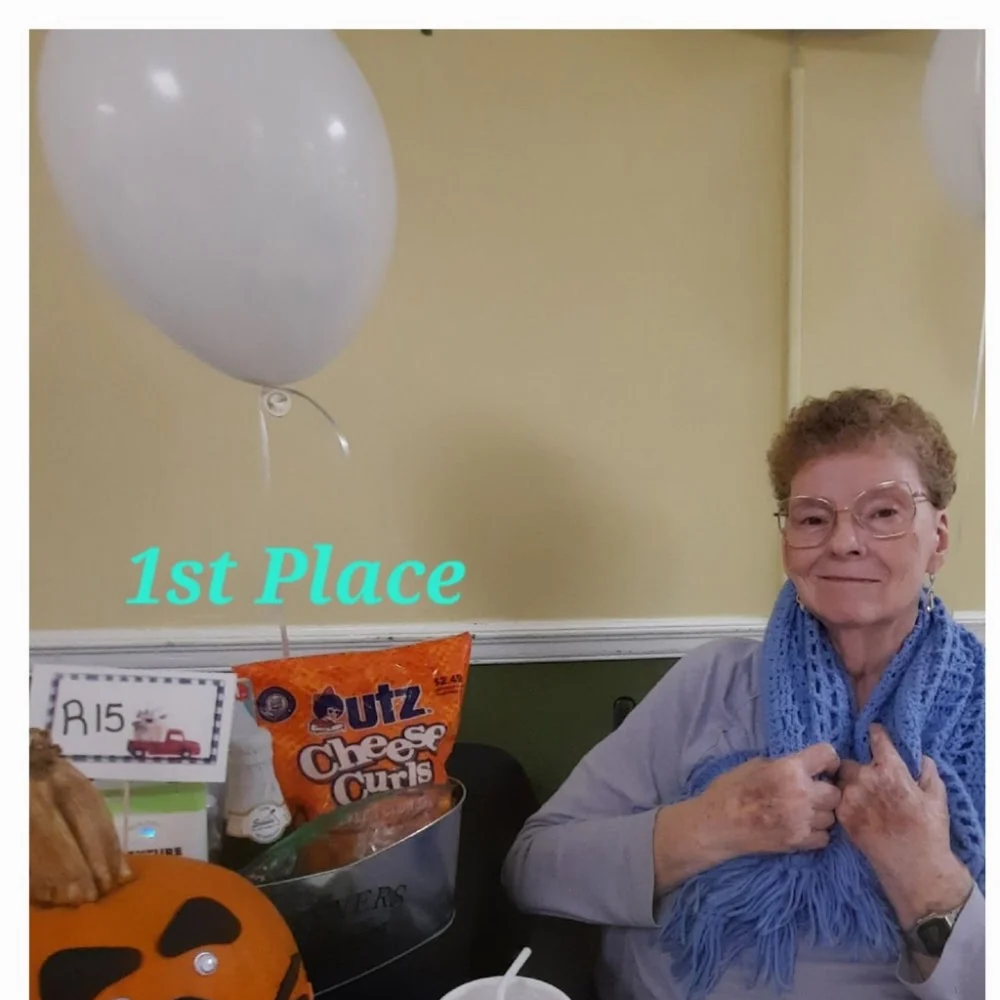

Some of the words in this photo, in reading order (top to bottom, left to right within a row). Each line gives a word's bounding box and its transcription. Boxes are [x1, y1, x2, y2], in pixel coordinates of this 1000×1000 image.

[61, 698, 126, 736] R15
[298, 722, 448, 784] Cheese
[331, 759, 433, 806] Curls
